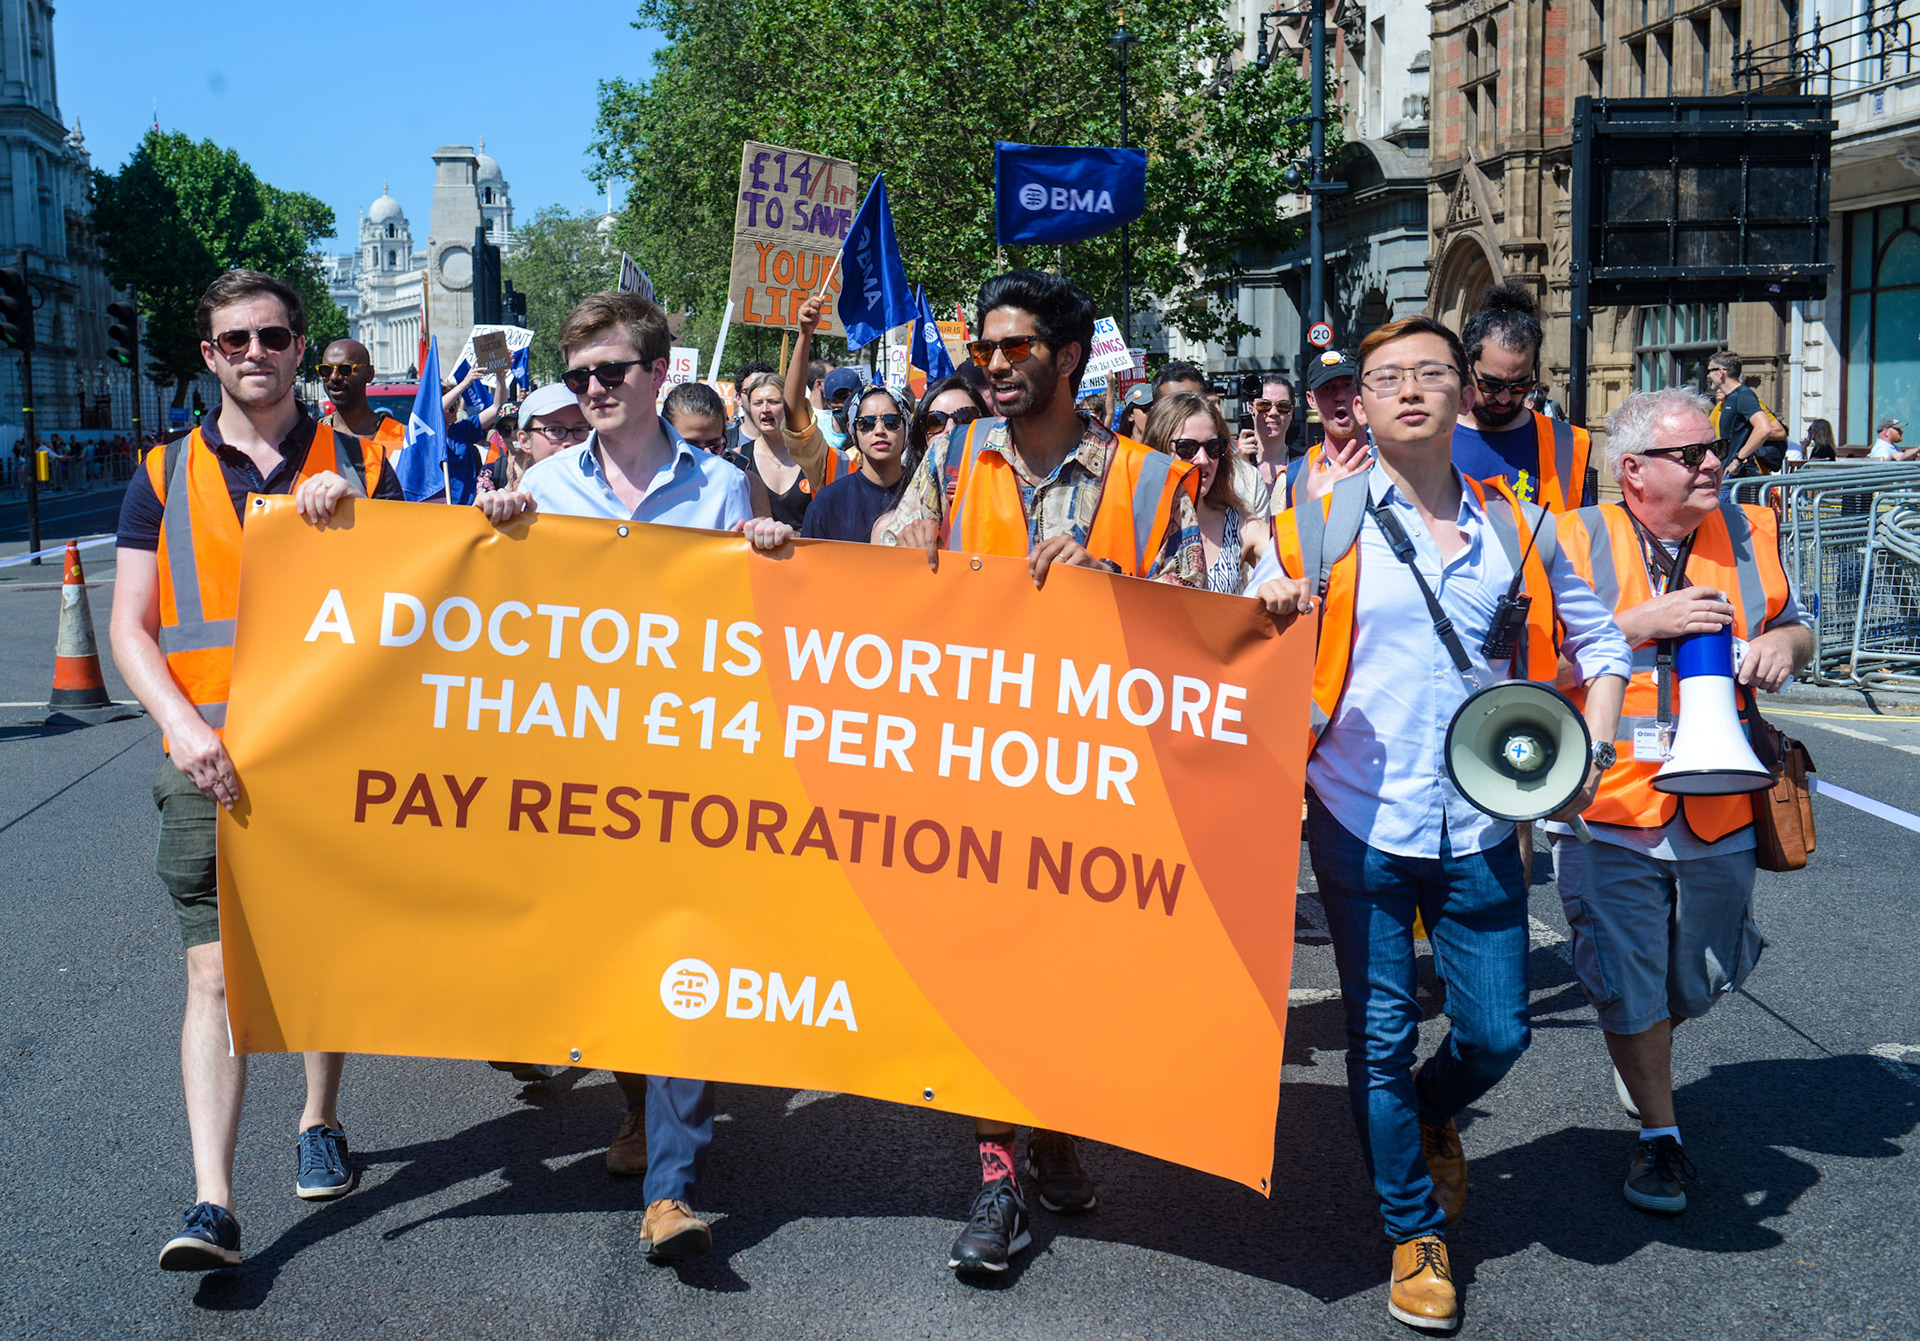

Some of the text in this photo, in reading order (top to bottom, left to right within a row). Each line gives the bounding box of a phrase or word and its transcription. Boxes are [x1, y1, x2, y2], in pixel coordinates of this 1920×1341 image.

[750, 152, 855, 205] £14/hr
[742, 192, 851, 240] TO SAVE
[1050, 187, 1115, 214] BMA
[754, 241, 842, 294] YOUR
[856, 250, 883, 312] BMA
[1094, 319, 1114, 334] VES
[1313, 329, 1330, 340] 20
[676, 358, 690, 372] IS
[1091, 338, 1124, 358] AVINGS
[665, 373, 690, 384] AGE
[897, 362, 905, 372] IS
[1089, 376, 1106, 387] NHS
[304, 588, 1248, 746] A DOCTOR IS WORTH MORE
[421, 673, 1139, 806] THAN £14 PER HOUR
[353, 768, 1187, 917] PAY RESTORATION NOW
[725, 967, 859, 1032] BMA
